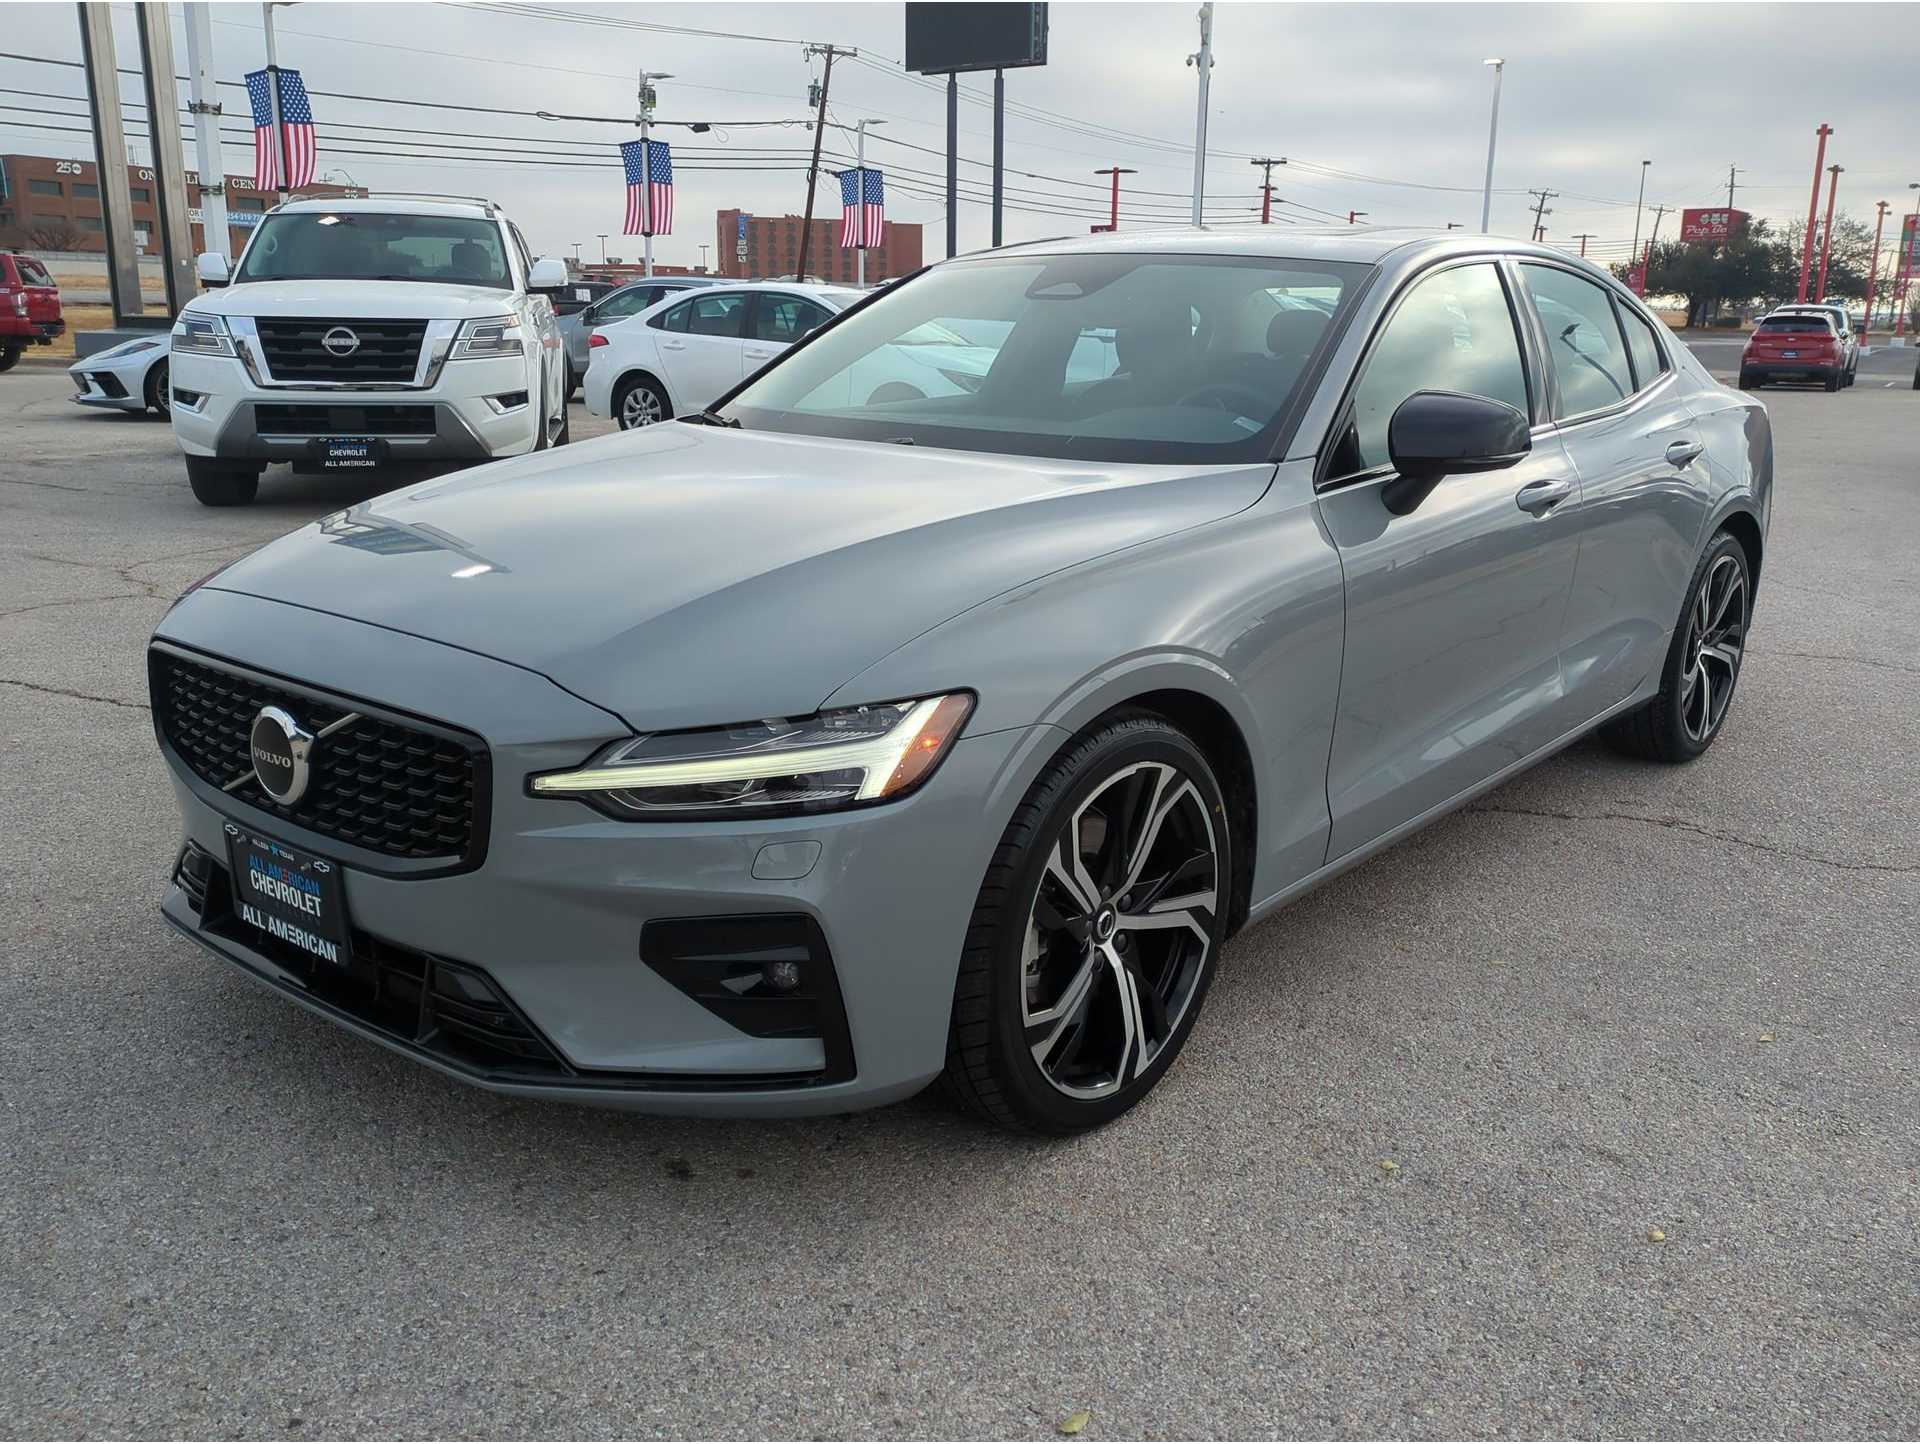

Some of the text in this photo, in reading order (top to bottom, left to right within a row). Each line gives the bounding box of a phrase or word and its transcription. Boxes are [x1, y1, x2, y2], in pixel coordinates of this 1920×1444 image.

[138, 169, 156, 181] ON
[232, 178, 256, 190] CEN
[329, 449, 368, 457] CHEVROLET
[254, 746, 292, 768] VOLVO
[249, 853, 321, 897] ALL AMERICAN
[250, 868, 322, 918] CHEVROLET
[242, 903, 338, 964] ALL AMERICAN
